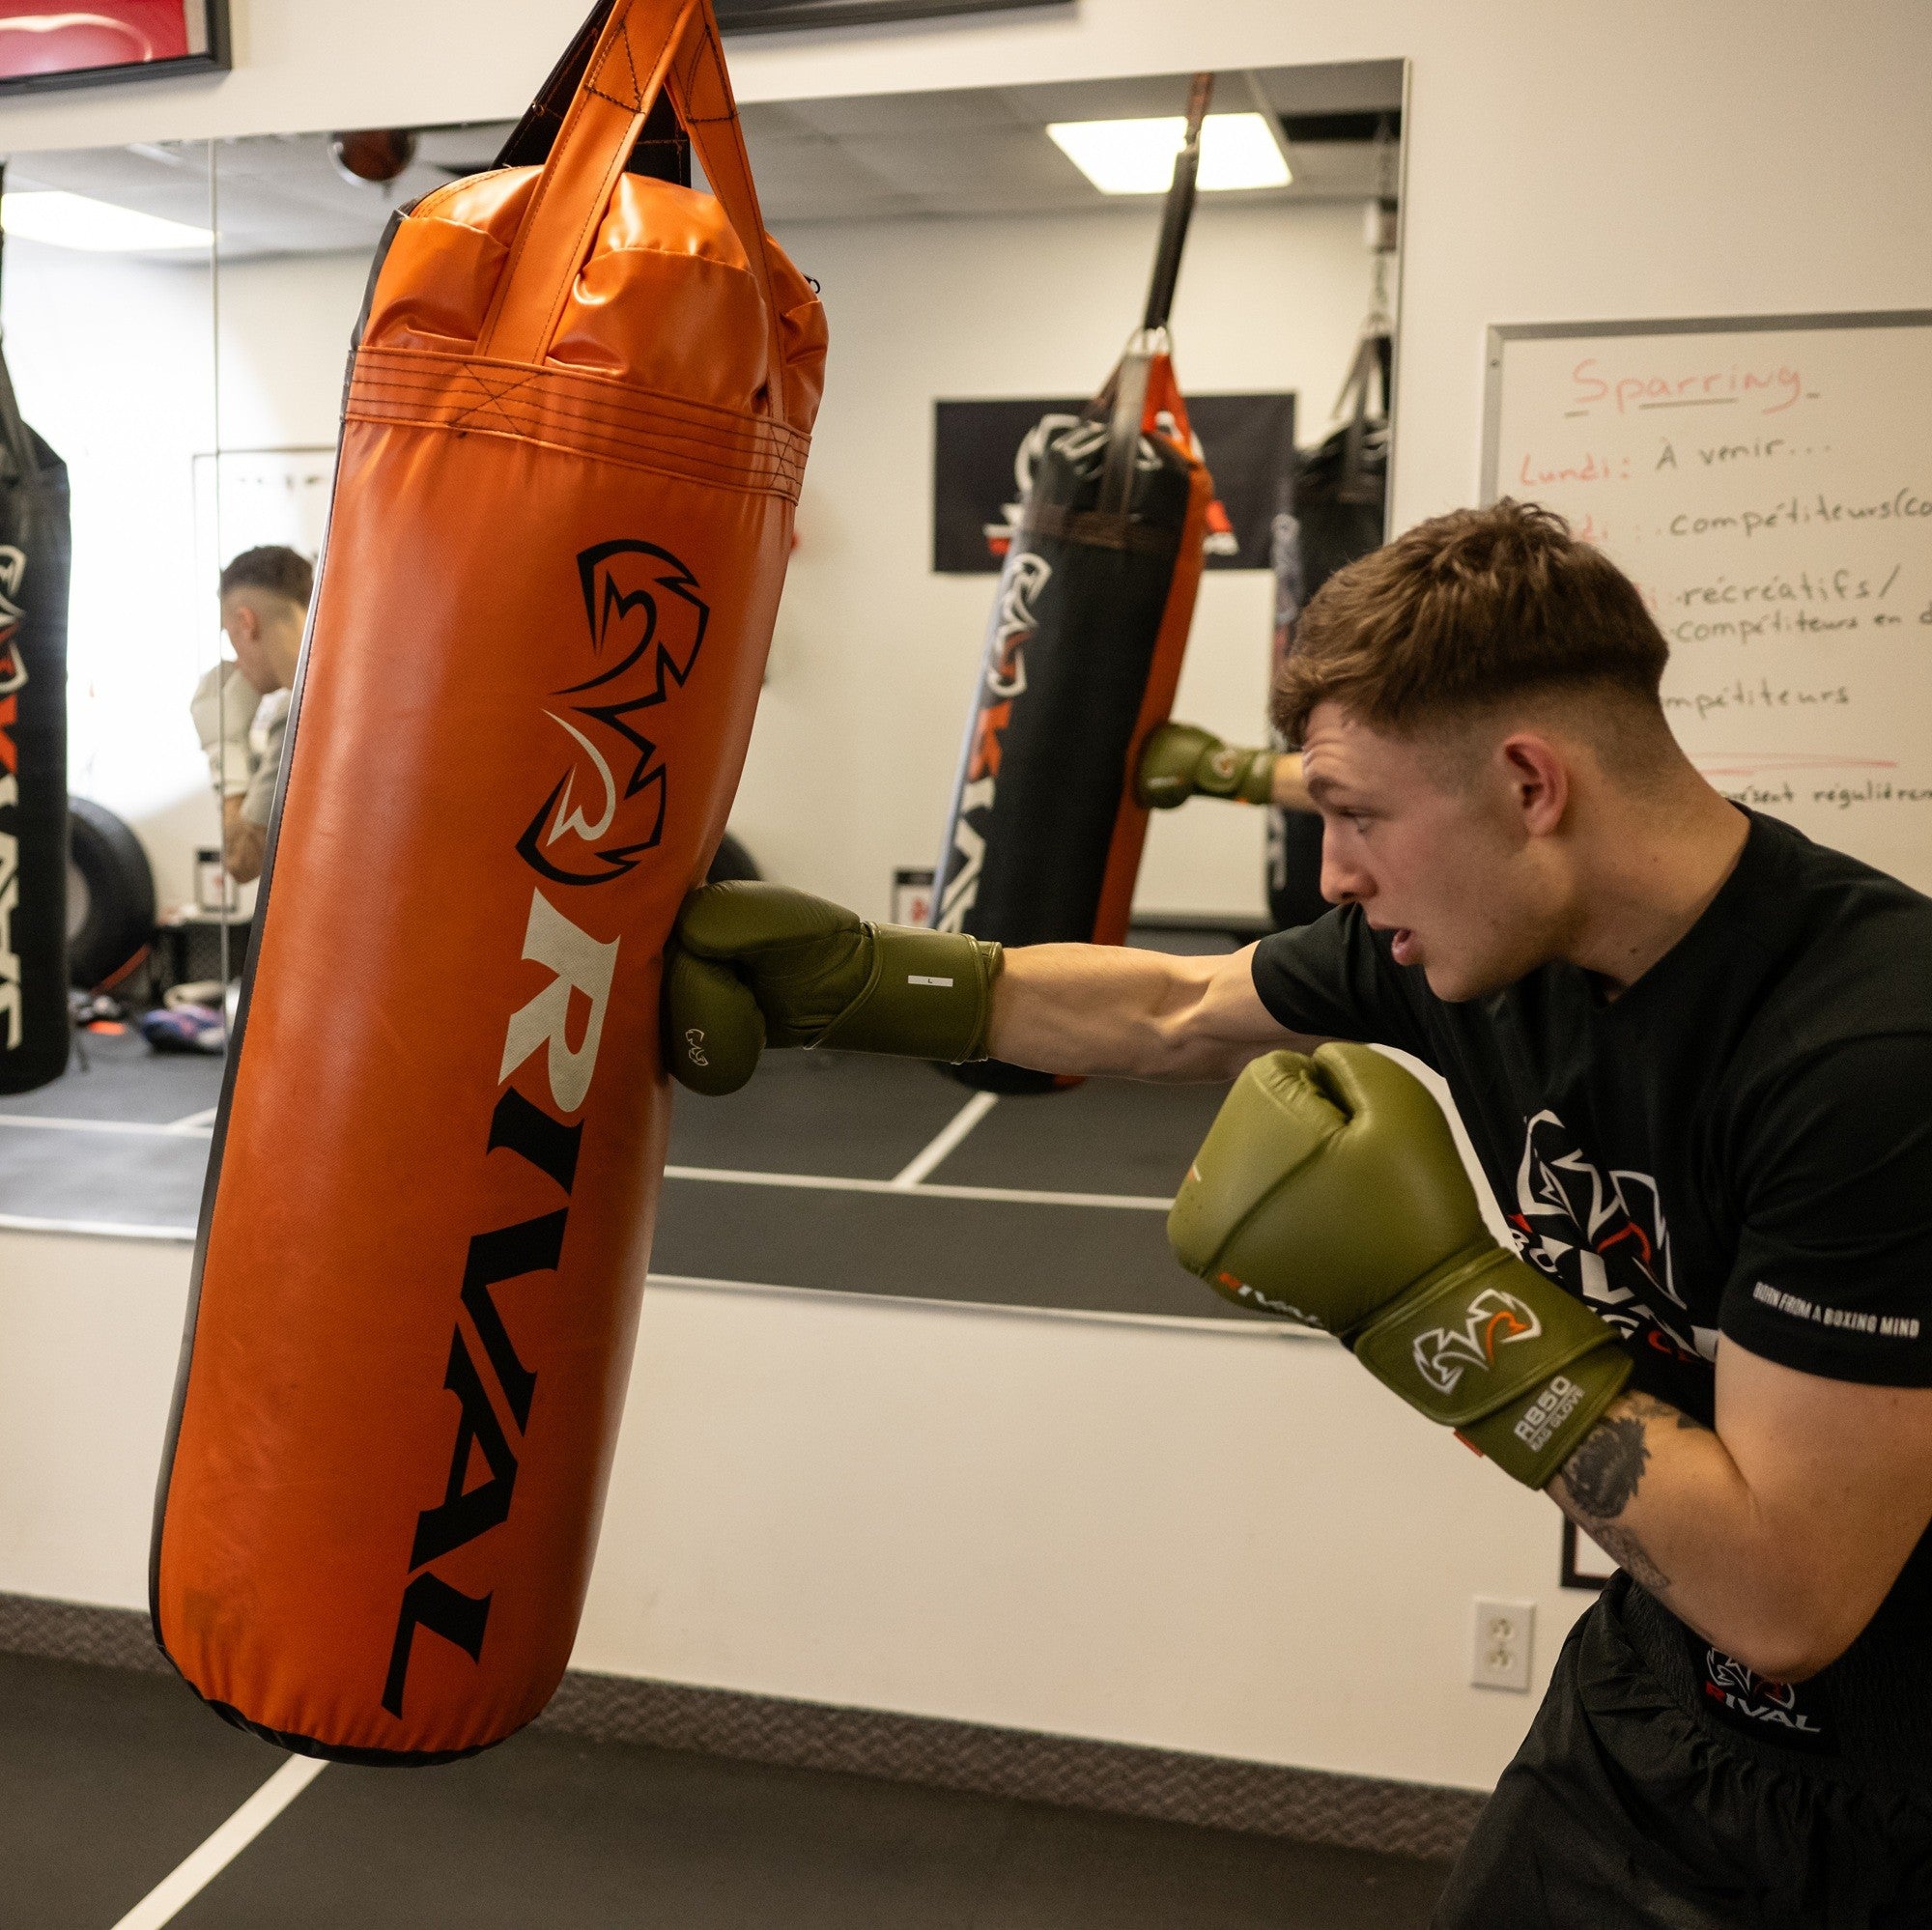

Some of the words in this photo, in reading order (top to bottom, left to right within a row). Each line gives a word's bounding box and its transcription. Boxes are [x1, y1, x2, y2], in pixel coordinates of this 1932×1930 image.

[1573, 357, 1801, 415] Sparring
[1664, 675, 1850, 720] mpétiteurs
[381, 885, 621, 1720] RIVAL
[1811, 1304, 1822, 1322] A
[1823, 1307, 1878, 1334] BOXING
[1879, 1316, 1920, 1339] MIND
[1705, 1681, 1821, 1732] RIVAL
